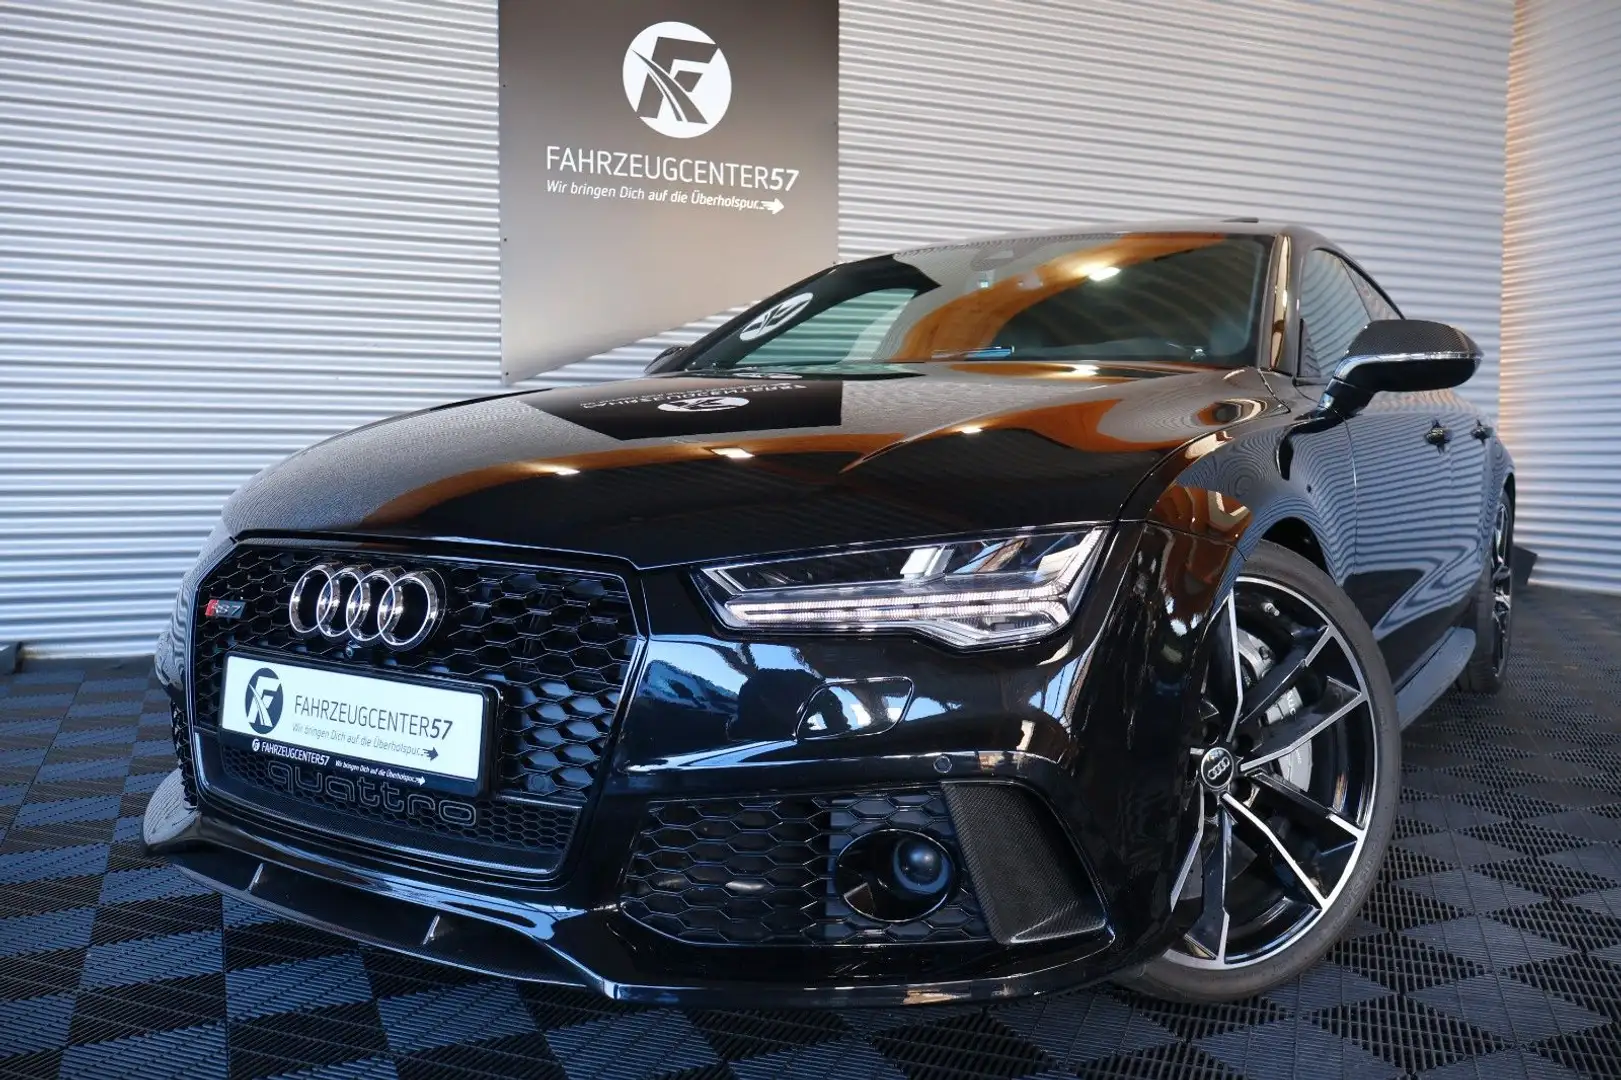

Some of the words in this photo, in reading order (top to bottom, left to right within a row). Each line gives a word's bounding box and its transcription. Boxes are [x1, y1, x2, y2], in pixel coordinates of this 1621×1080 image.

[546, 145, 799, 192] FAHRZEUGCENTER57
[547, 179, 567, 193] Wir
[570, 181, 616, 199] bringen
[619, 186, 645, 200] Dich
[648, 189, 668, 202] auf
[670, 190, 688, 204] die
[294, 694, 453, 740] FAHRZEUGCENTER57
[304, 724, 330, 740] bringen
[330, 729, 346, 741] Dich
[347, 734, 361, 745] auf
[361, 735, 373, 747] die
[261, 741, 330, 766] FAHRZEUGCENTER57
[268, 760, 476, 827] quattro
